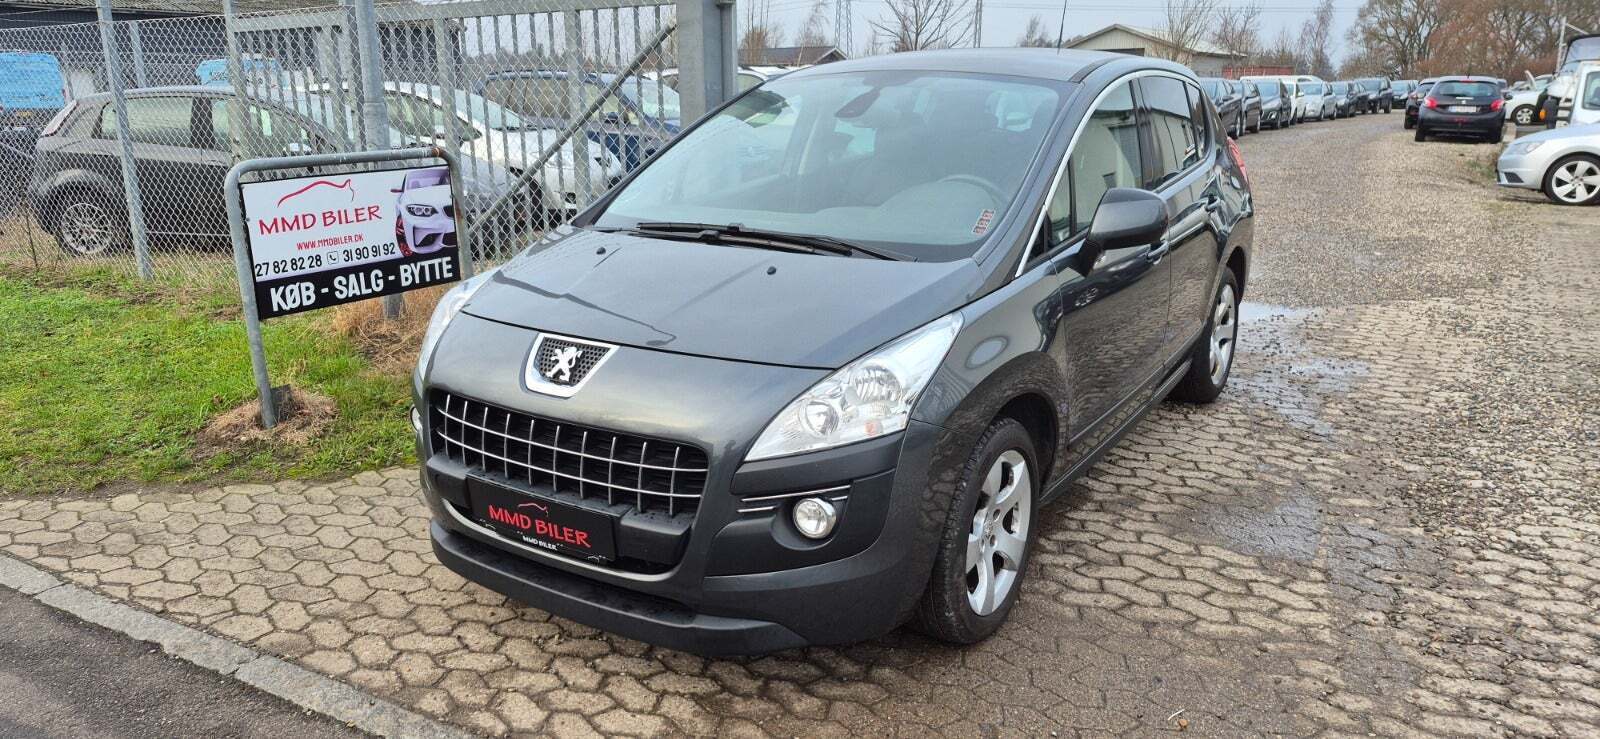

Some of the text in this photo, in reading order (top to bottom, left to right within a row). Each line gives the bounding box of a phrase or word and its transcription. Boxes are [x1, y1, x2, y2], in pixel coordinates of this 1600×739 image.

[259, 204, 382, 235] MMD BILER
[255, 242, 396, 277] 27 82 82 28 31 90 91 92
[270, 281, 315, 312] KØB
[334, 269, 384, 299] SALG
[400, 256, 453, 288] BYTTE
[488, 504, 592, 548] MMD BILER
